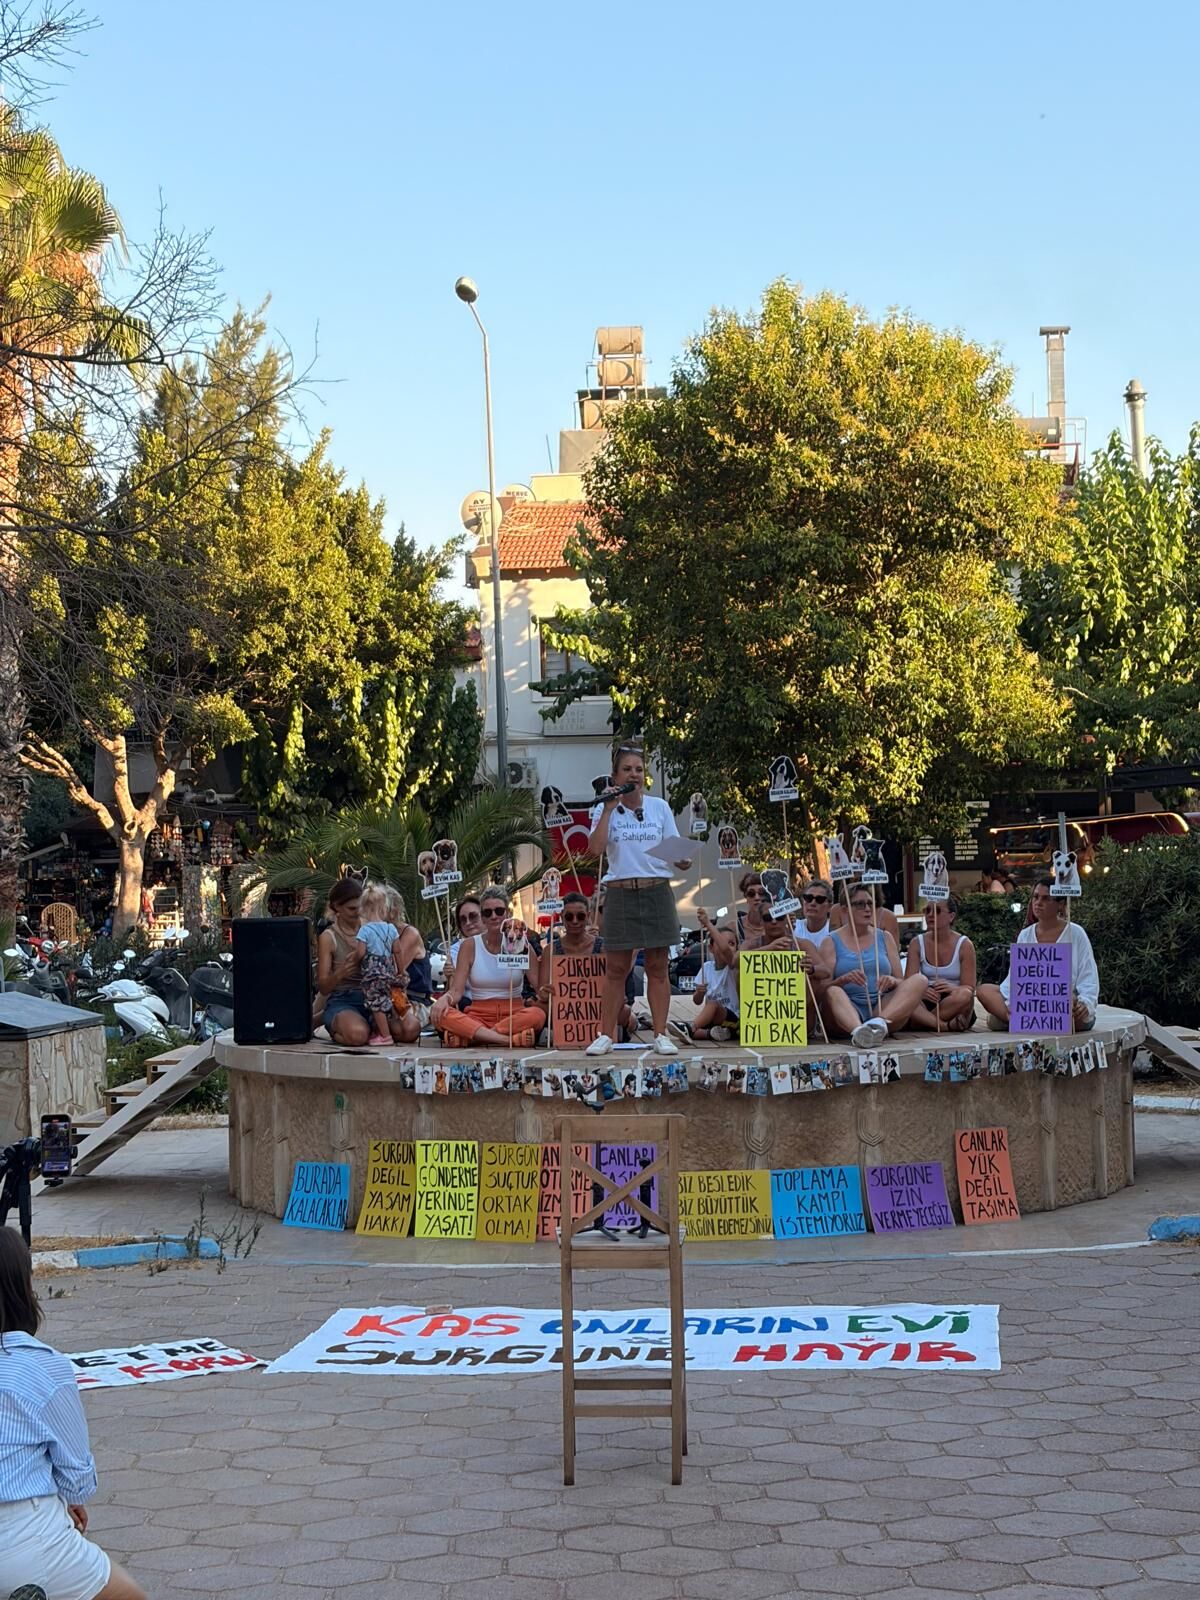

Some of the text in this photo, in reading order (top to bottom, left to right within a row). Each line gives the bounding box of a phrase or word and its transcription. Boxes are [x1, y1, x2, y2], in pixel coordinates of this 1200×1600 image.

[623, 832, 656, 842] Sahiplen
[742, 952, 805, 974] YERİNDEN
[1018, 946, 1062, 961] NAKİL
[754, 978, 797, 996] ETME
[1016, 982, 1068, 996] YERELDE
[558, 1001, 602, 1021] BARIN
[744, 998, 804, 1020] YERİNDE
[770, 1022, 802, 1044] BAK
[1021, 1016, 1062, 1030] BAKIM
[960, 1129, 1006, 1152] CANLAR
[420, 1142, 478, 1164] TOPLAMA
[486, 1144, 539, 1166] SÜRGÜN
[968, 1152, 1000, 1175] YÜK
[295, 1164, 342, 1195] BURADA
[485, 1170, 538, 1191] SUÇTUR
[678, 1173, 695, 1194] BİZ
[698, 1172, 756, 1193] BESLEDİK
[772, 1168, 848, 1192] TOPLAMA
[966, 1174, 1008, 1198] DEĞİL
[418, 1190, 475, 1212] YERİNDE
[482, 1195, 533, 1214] ORTAK
[678, 1193, 759, 1216] BİZ BÜYÜTTÜK
[796, 1190, 847, 1214] KAMPI
[890, 1186, 924, 1206] İZİN
[874, 1201, 952, 1229] VERMEYECEĞİZ
[966, 1198, 1018, 1220] TAŞIMA
[364, 1214, 405, 1234] HAKKI
[423, 1214, 473, 1236] YAŞAT!
[486, 1219, 530, 1238] OLMA!
[679, 1218, 715, 1237] ÜRGÜN
[780, 1213, 864, 1236] İSTEMİYORUZ
[540, 1317, 829, 1336] ONLARIN
[848, 1311, 971, 1334] EVİ
[732, 1339, 977, 1363] HAYIR
[118, 1354, 258, 1378] KORU
